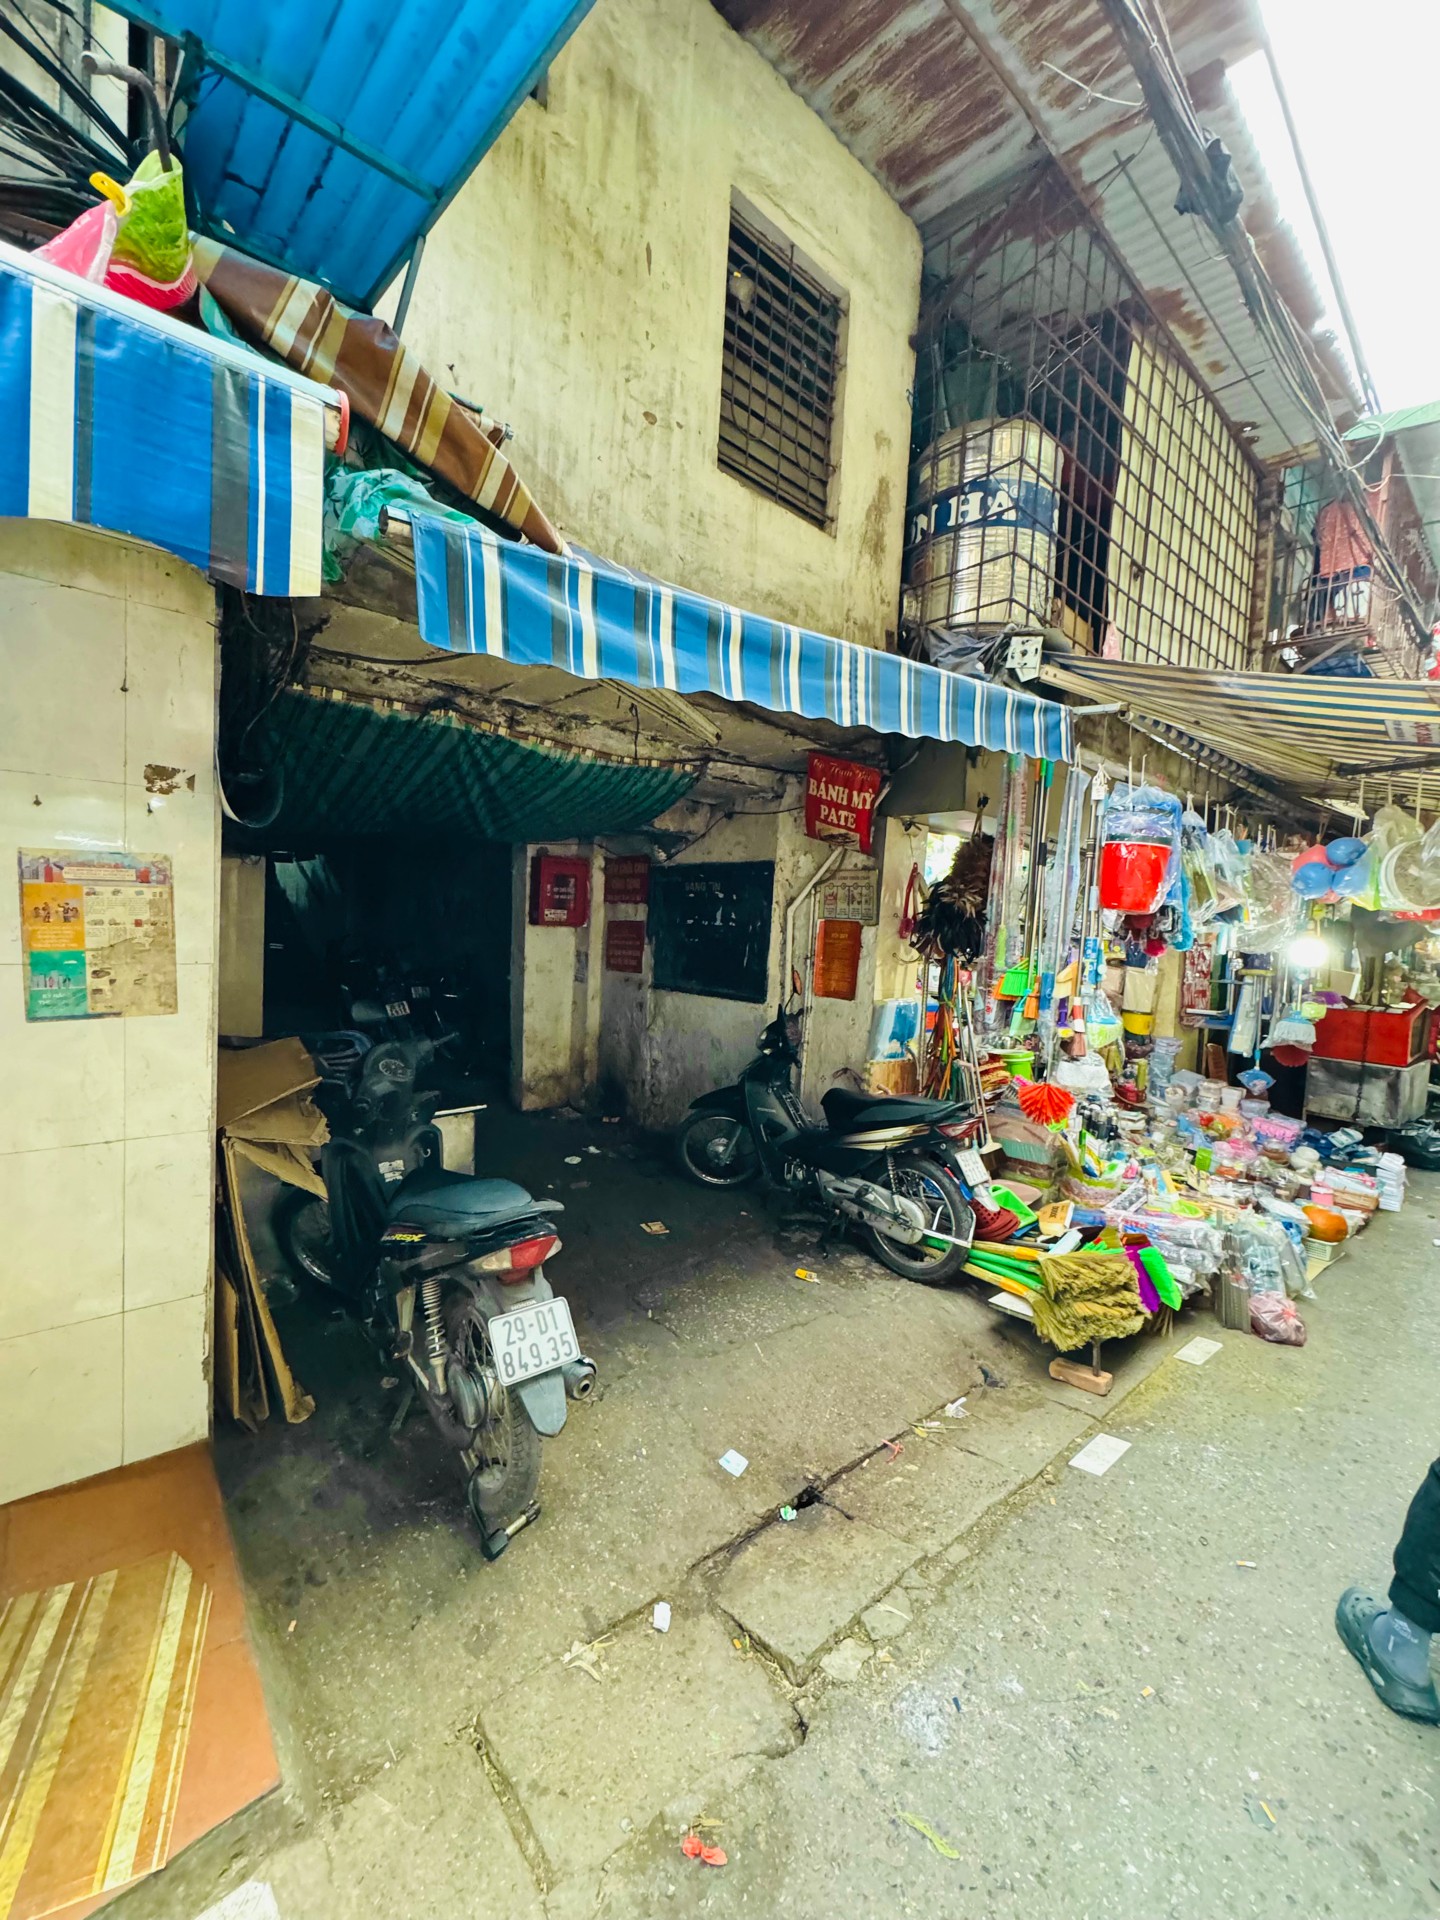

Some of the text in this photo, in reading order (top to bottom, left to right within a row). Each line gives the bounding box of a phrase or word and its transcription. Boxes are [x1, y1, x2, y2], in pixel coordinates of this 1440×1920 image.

[808, 777, 875, 810] BÁNH MỲ
[820, 804, 857, 829] PATE
[502, 1306, 558, 1346] 29-D1
[502, 1331, 573, 1378] 849.35
